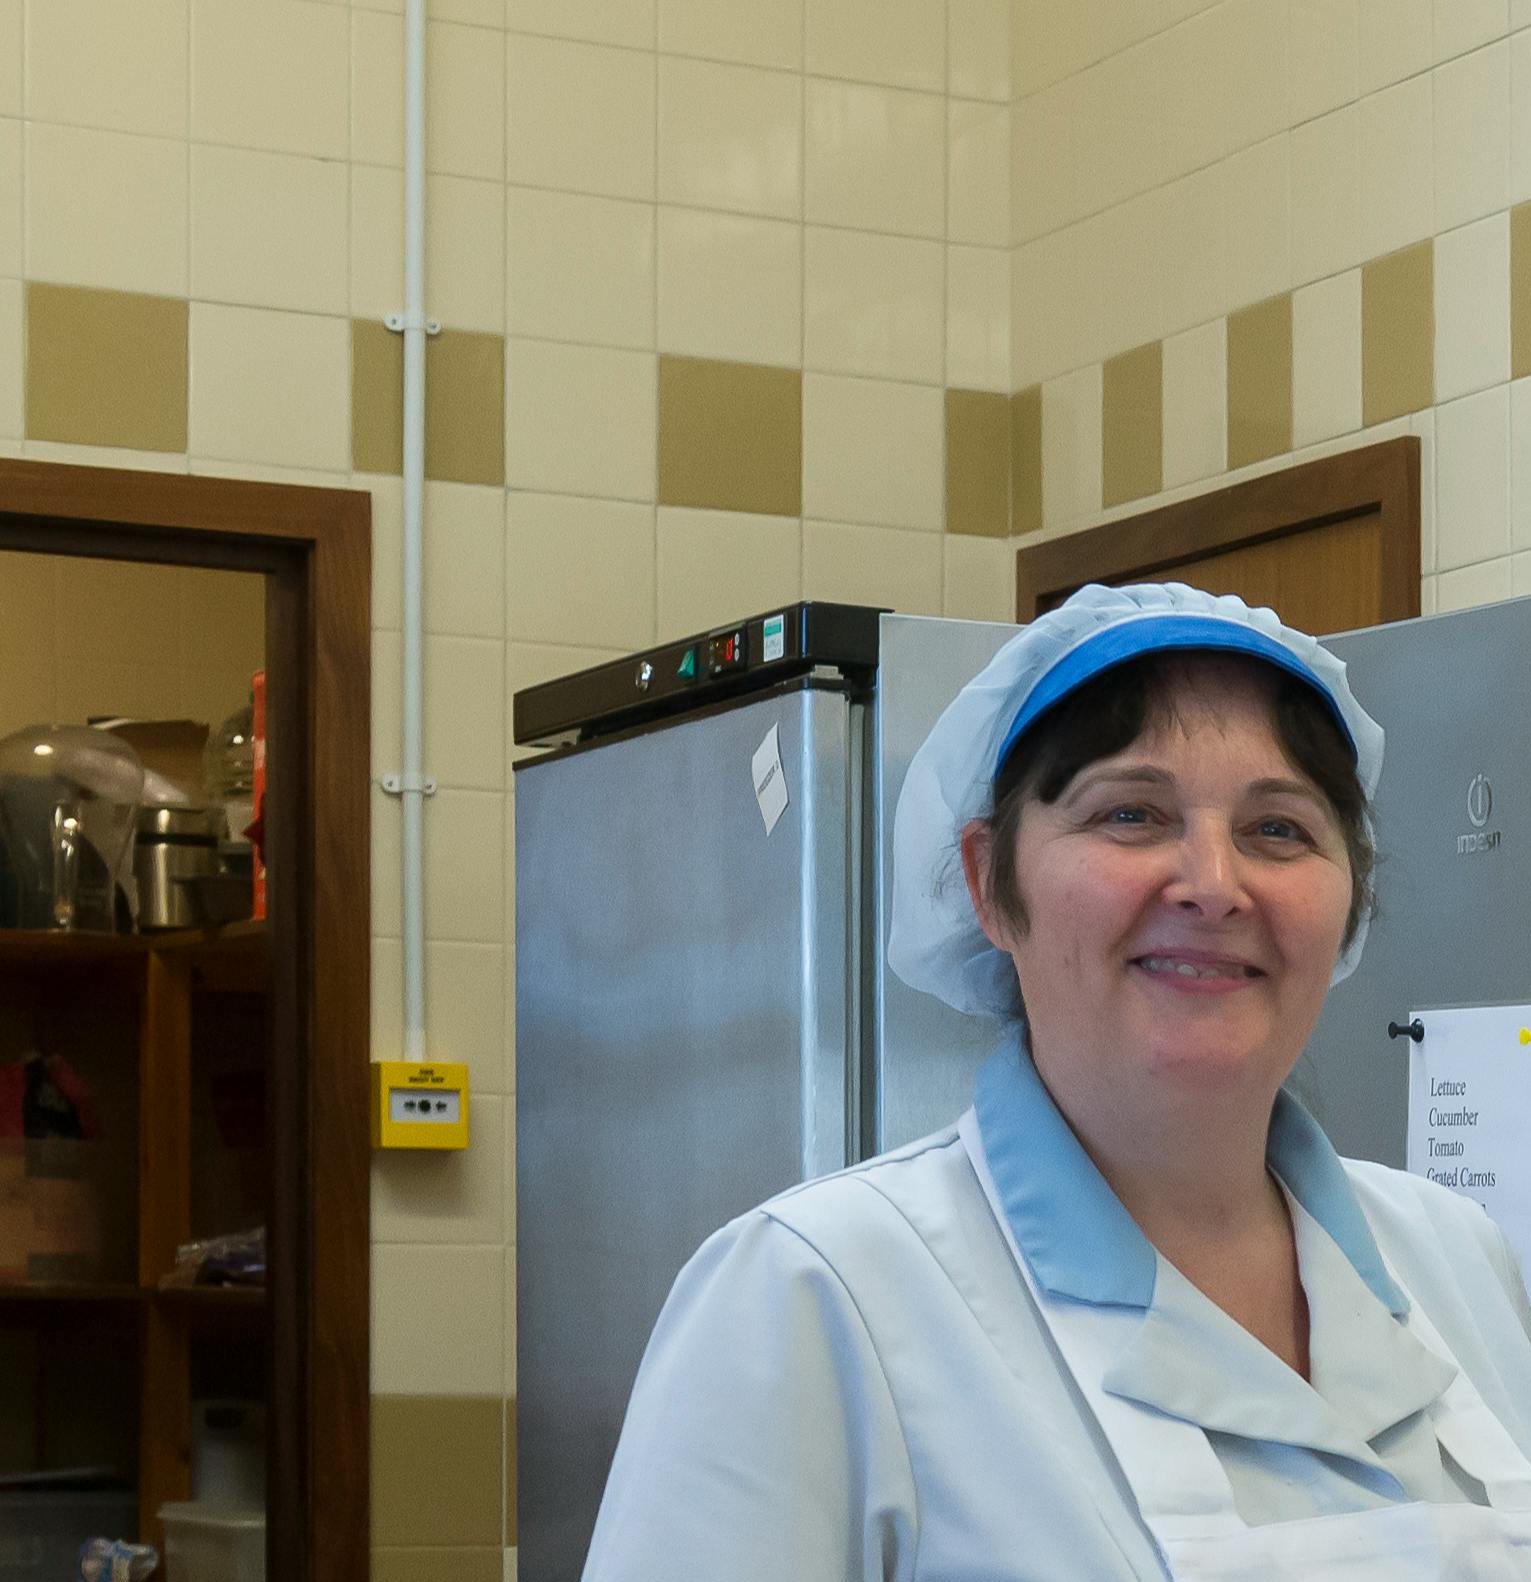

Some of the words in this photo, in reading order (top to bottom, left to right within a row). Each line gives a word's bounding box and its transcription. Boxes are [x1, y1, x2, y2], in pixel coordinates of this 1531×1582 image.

[1430, 1077, 1466, 1097] Lettuce
[1429, 1107, 1479, 1127] Cucumber
[1428, 1138, 1464, 1157] Tomato
[1460, 1167, 1496, 1187] Carrots
